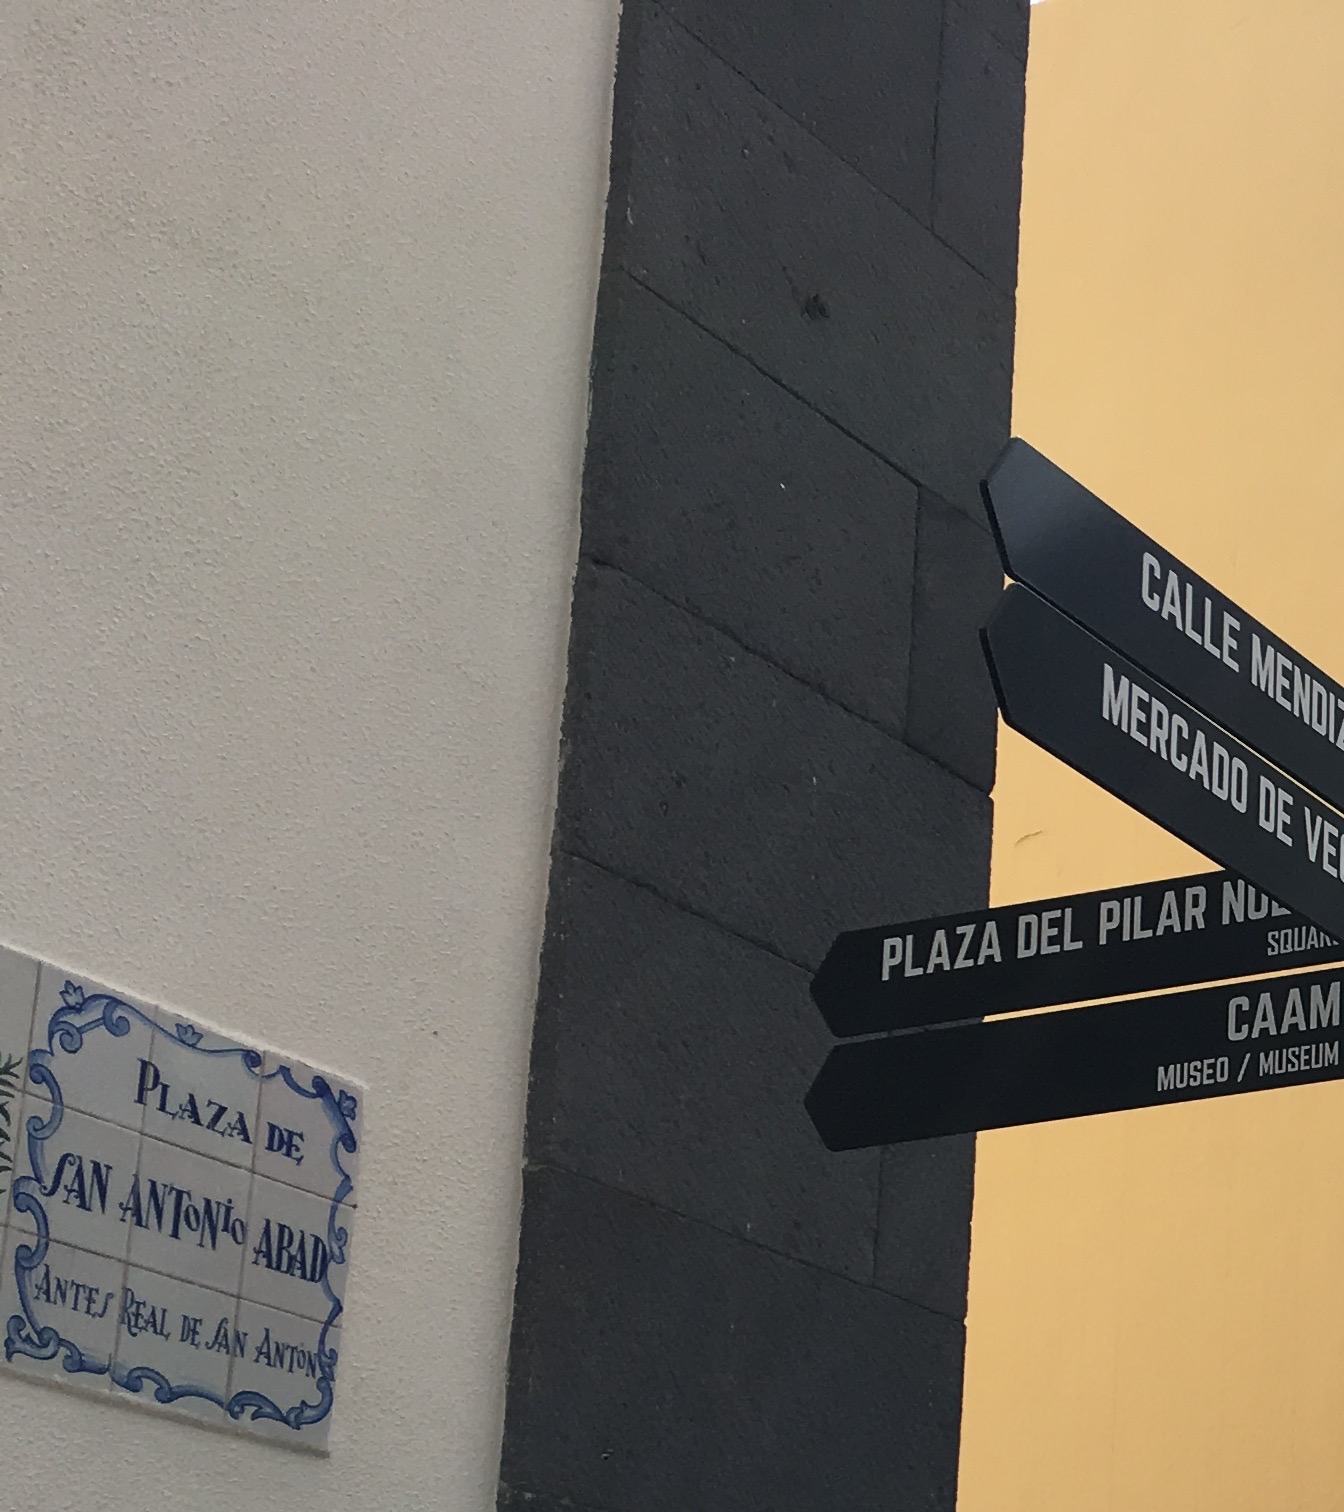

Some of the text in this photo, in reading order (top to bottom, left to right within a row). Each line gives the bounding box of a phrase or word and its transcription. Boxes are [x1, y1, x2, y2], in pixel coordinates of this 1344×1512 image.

[1142, 552, 1240, 673] CALLE
[1102, 662, 1248, 814] MERCADO
[1258, 774, 1294, 847] DE
[881, 920, 1002, 981] PLAZA
[1017, 907, 1083, 959] DEL
[1099, 886, 1207, 945] PILAR
[1227, 981, 1341, 1041] CAAM
[133, 1057, 305, 1166] PLAZA DE
[1157, 1056, 1229, 1092] MUSEO
[1259, 1040, 1339, 1077] MUSEUM
[40, 1152, 113, 1215] SAN
[252, 1217, 328, 1284] ABAD
[34, 1263, 114, 1319] ANTES
[120, 1287, 171, 1338] REAL
[179, 1314, 203, 1347] DE
[205, 1317, 249, 1359] SAN
